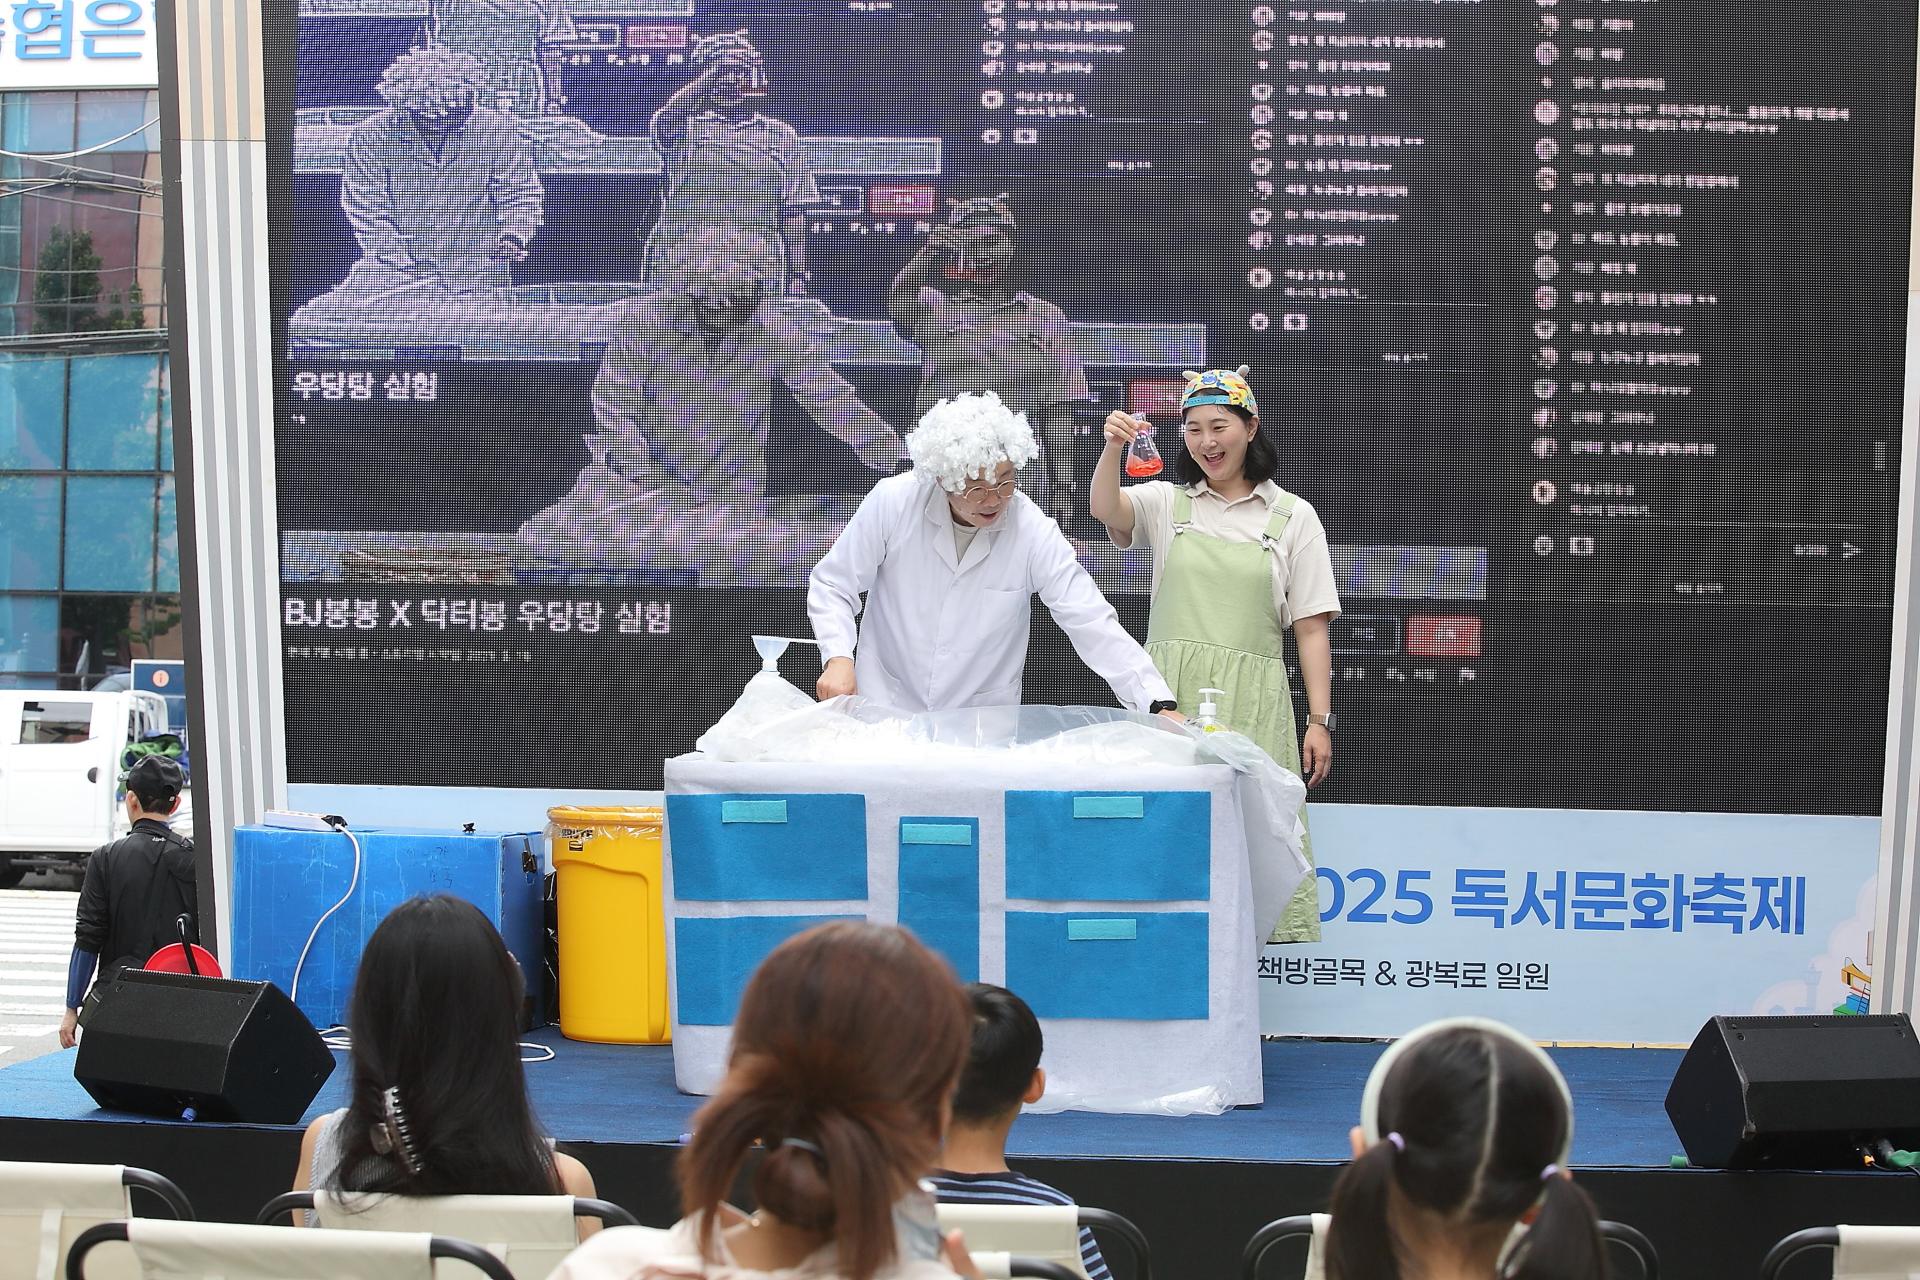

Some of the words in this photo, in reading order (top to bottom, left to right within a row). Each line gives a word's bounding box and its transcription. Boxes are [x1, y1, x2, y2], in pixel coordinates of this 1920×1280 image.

[0, 0, 156, 60] 협은
[292, 371, 375, 401] 우당탕
[383, 371, 438, 402] 실험
[389, 599, 413, 628] X
[517, 600, 604, 633] 우당탕
[615, 601, 672, 634] 실험
[1316, 867, 1433, 925] 025
[1451, 868, 1807, 936] 독서문화축제
[1257, 956, 1366, 987] 책방골목
[1375, 960, 1397, 987] &
[1405, 960, 1488, 990] 광복로
[1496, 962, 1550, 991] 일원
